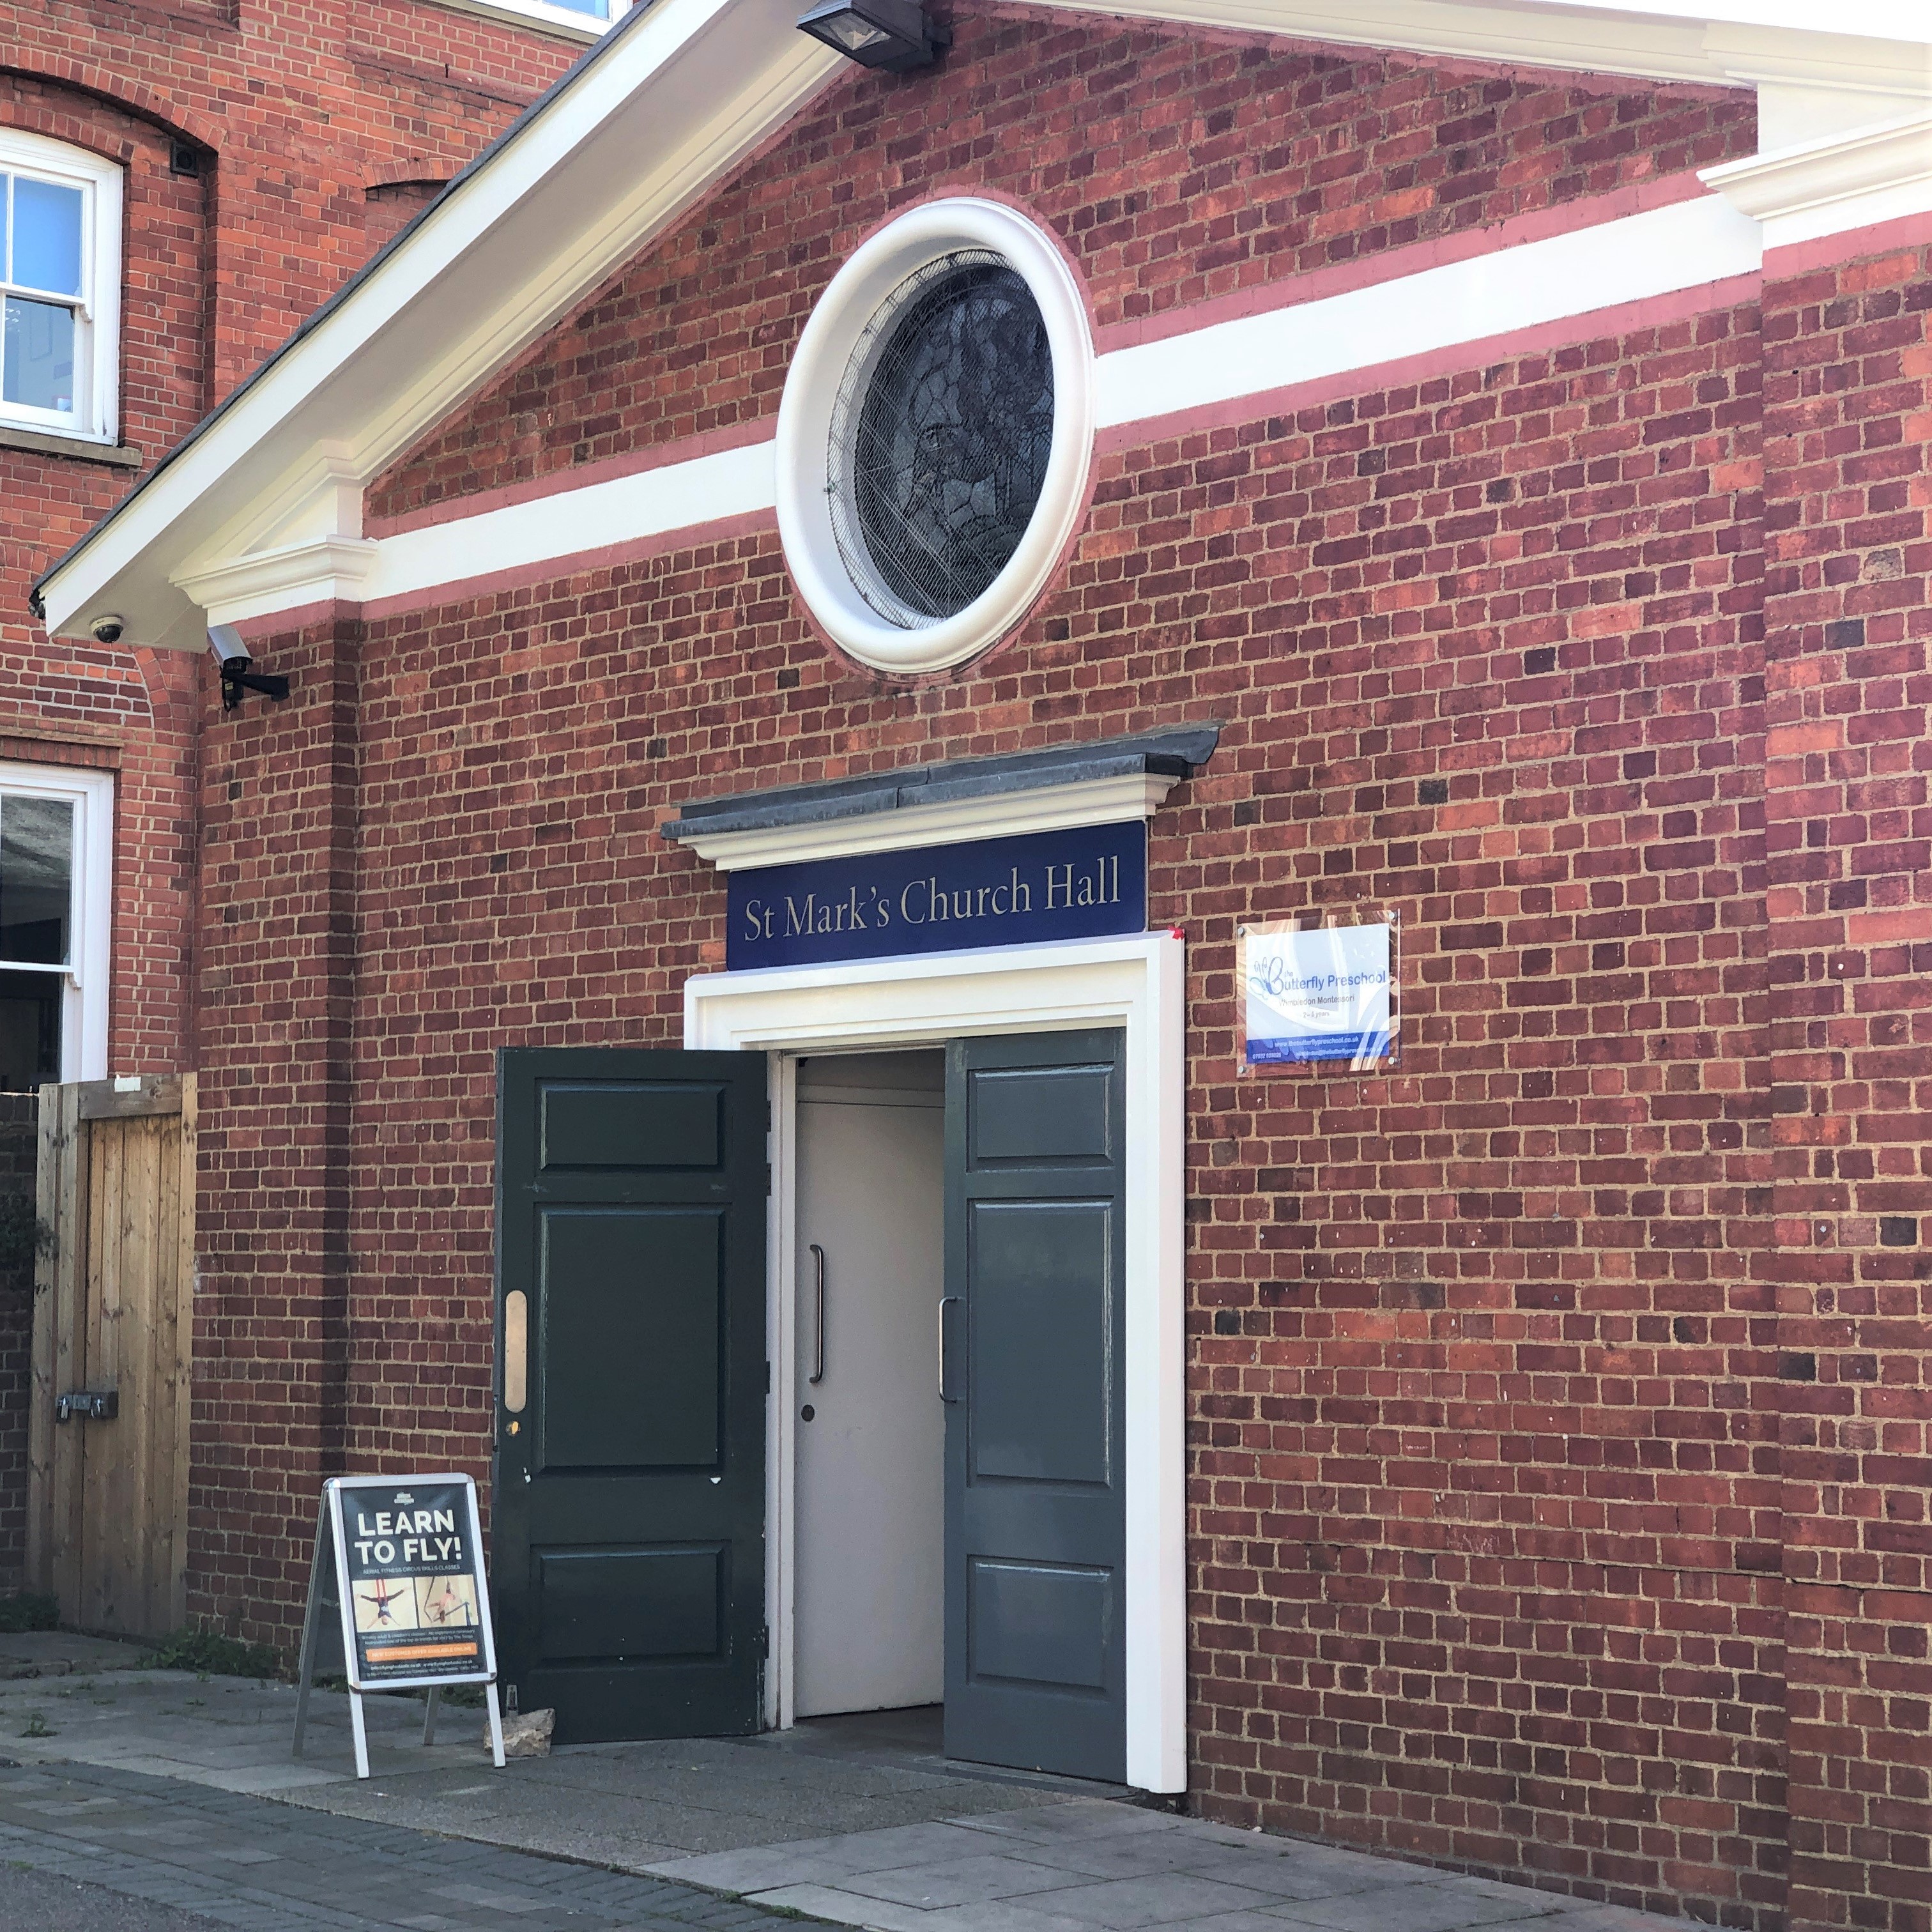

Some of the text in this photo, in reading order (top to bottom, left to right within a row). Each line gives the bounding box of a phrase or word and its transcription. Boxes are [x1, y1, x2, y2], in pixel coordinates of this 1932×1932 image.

[744, 855, 1121, 942] St Mark's Church Hall
[1268, 956, 1386, 996] Butterfly Preschool
[1279, 993, 1355, 1007] Wimbledon Montessori
[358, 1509, 454, 1537] LEARN
[355, 1537, 462, 1565] TO FLY!
